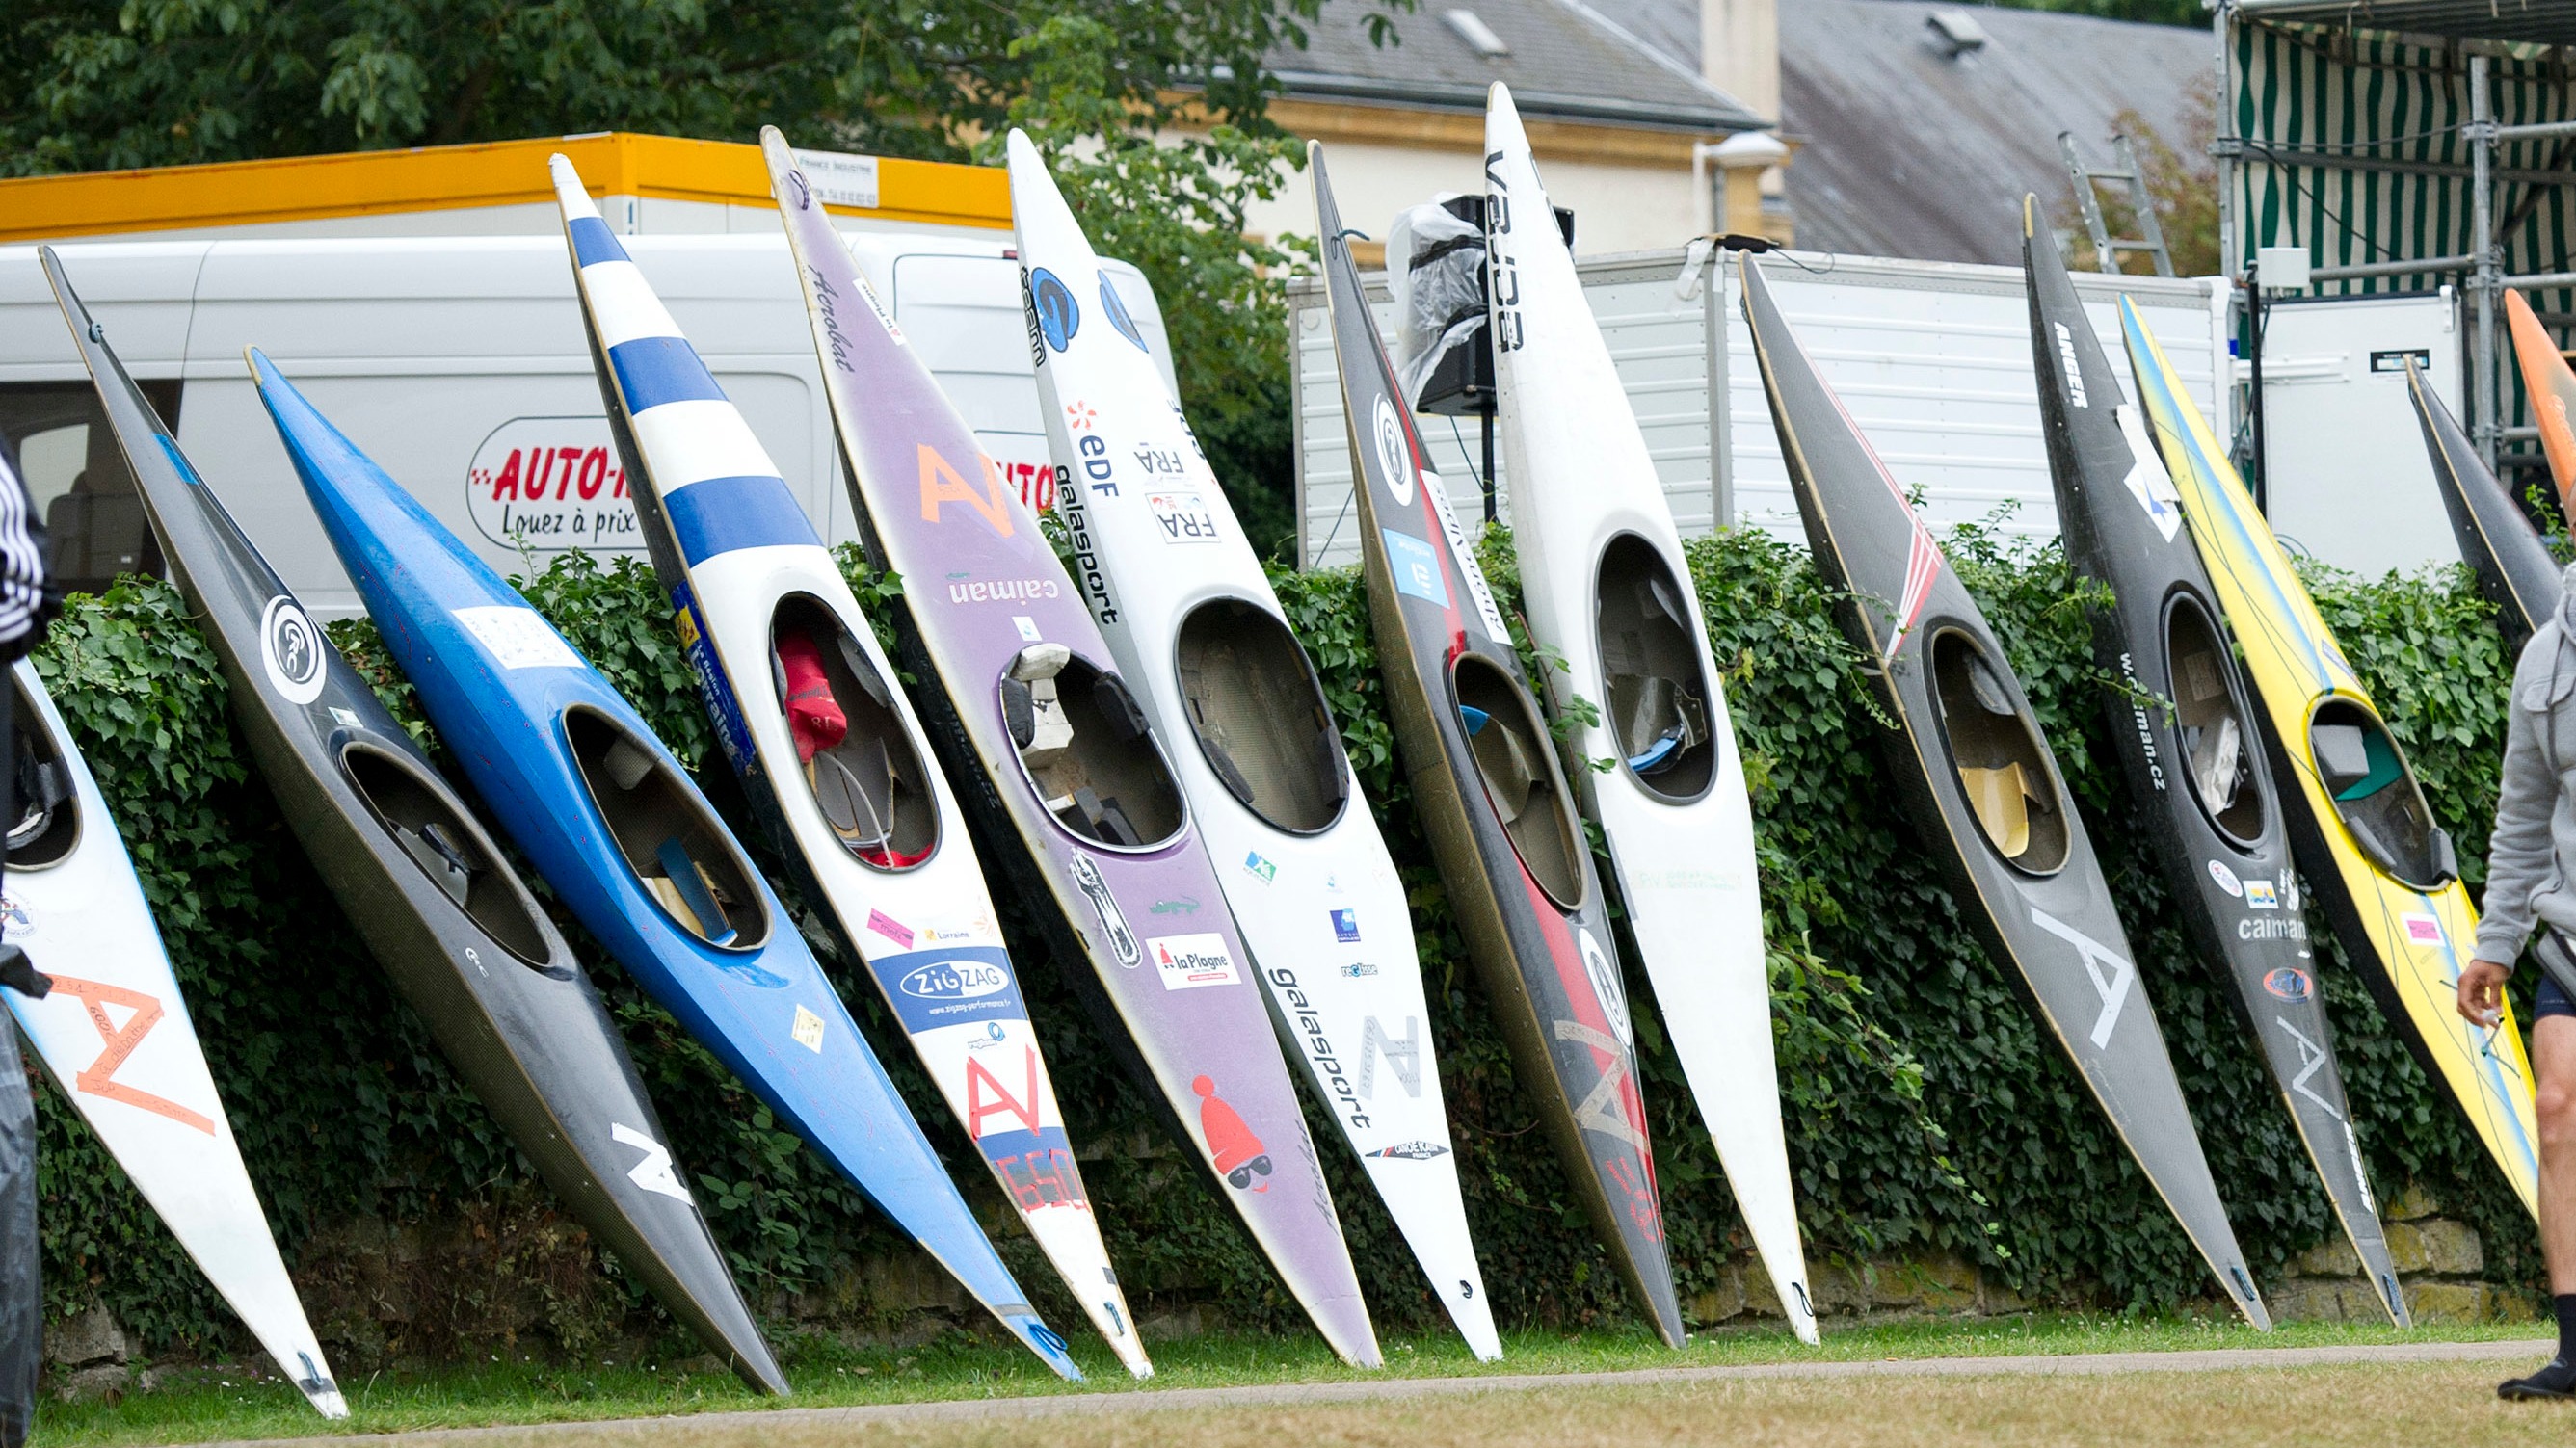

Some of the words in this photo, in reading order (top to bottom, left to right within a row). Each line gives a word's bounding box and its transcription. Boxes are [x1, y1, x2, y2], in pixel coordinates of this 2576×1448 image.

[808, 266, 854, 372] Acrobat
[1020, 266, 1046, 368] team
[2053, 321, 2087, 408] ANGER
[1133, 450, 1183, 474] FRA
[503, 505, 563, 535] Louez
[572, 508, 585, 531] à
[594, 512, 636, 541] prix
[1156, 513, 1218, 539] FRA
[1056, 465, 1118, 625] galasport
[949, 580, 1059, 606] caiman
[936, 928, 969, 941] Lorraine
[2238, 911, 2307, 940] caiman
[1269, 968, 1372, 1129] galasport
